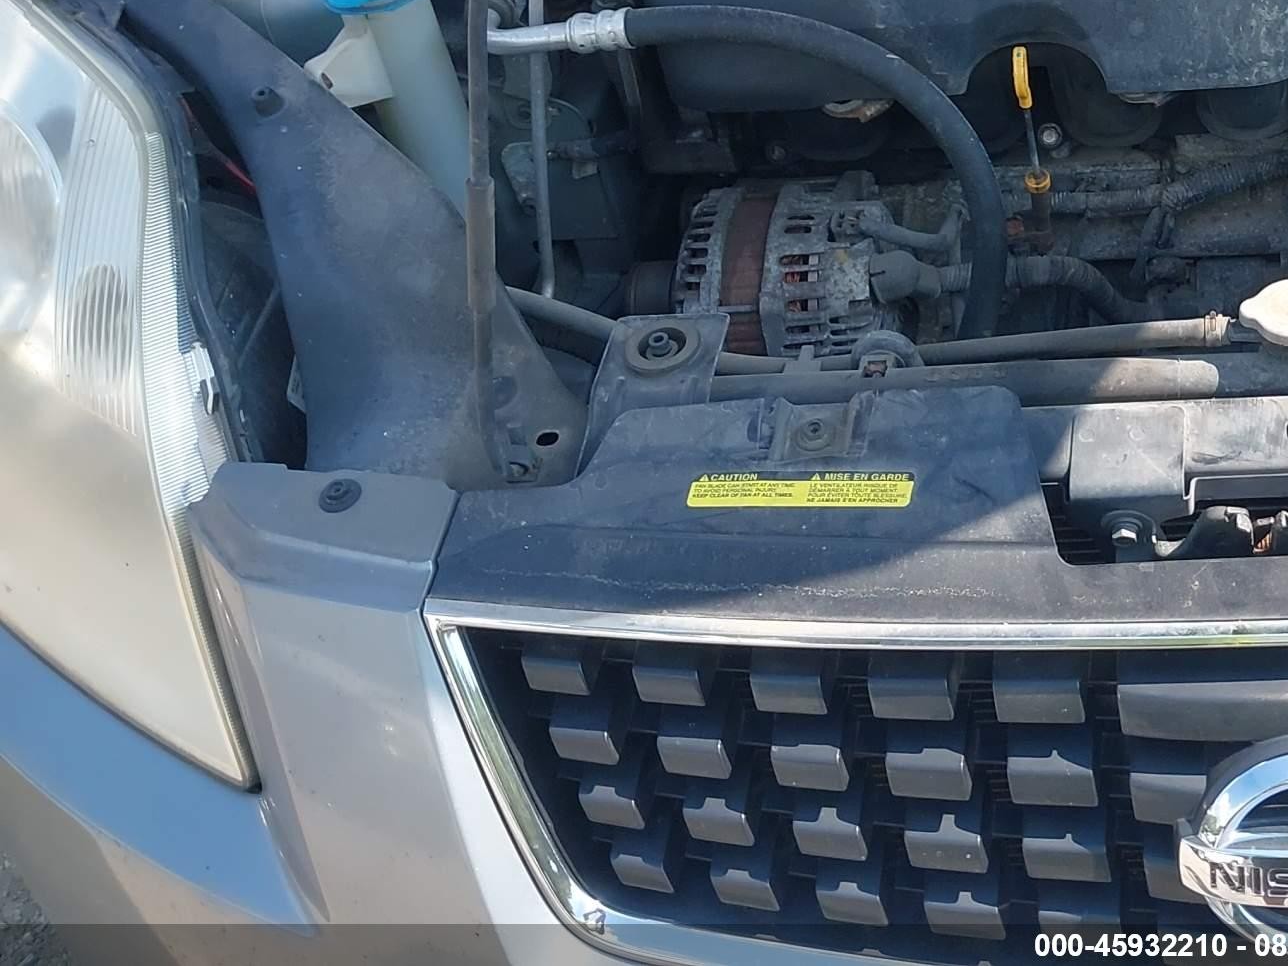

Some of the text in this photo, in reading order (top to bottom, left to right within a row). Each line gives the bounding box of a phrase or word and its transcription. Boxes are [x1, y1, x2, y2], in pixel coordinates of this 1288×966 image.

[710, 473, 758, 481] CAUTION
[824, 473, 909, 481] MISE EN GARDE
